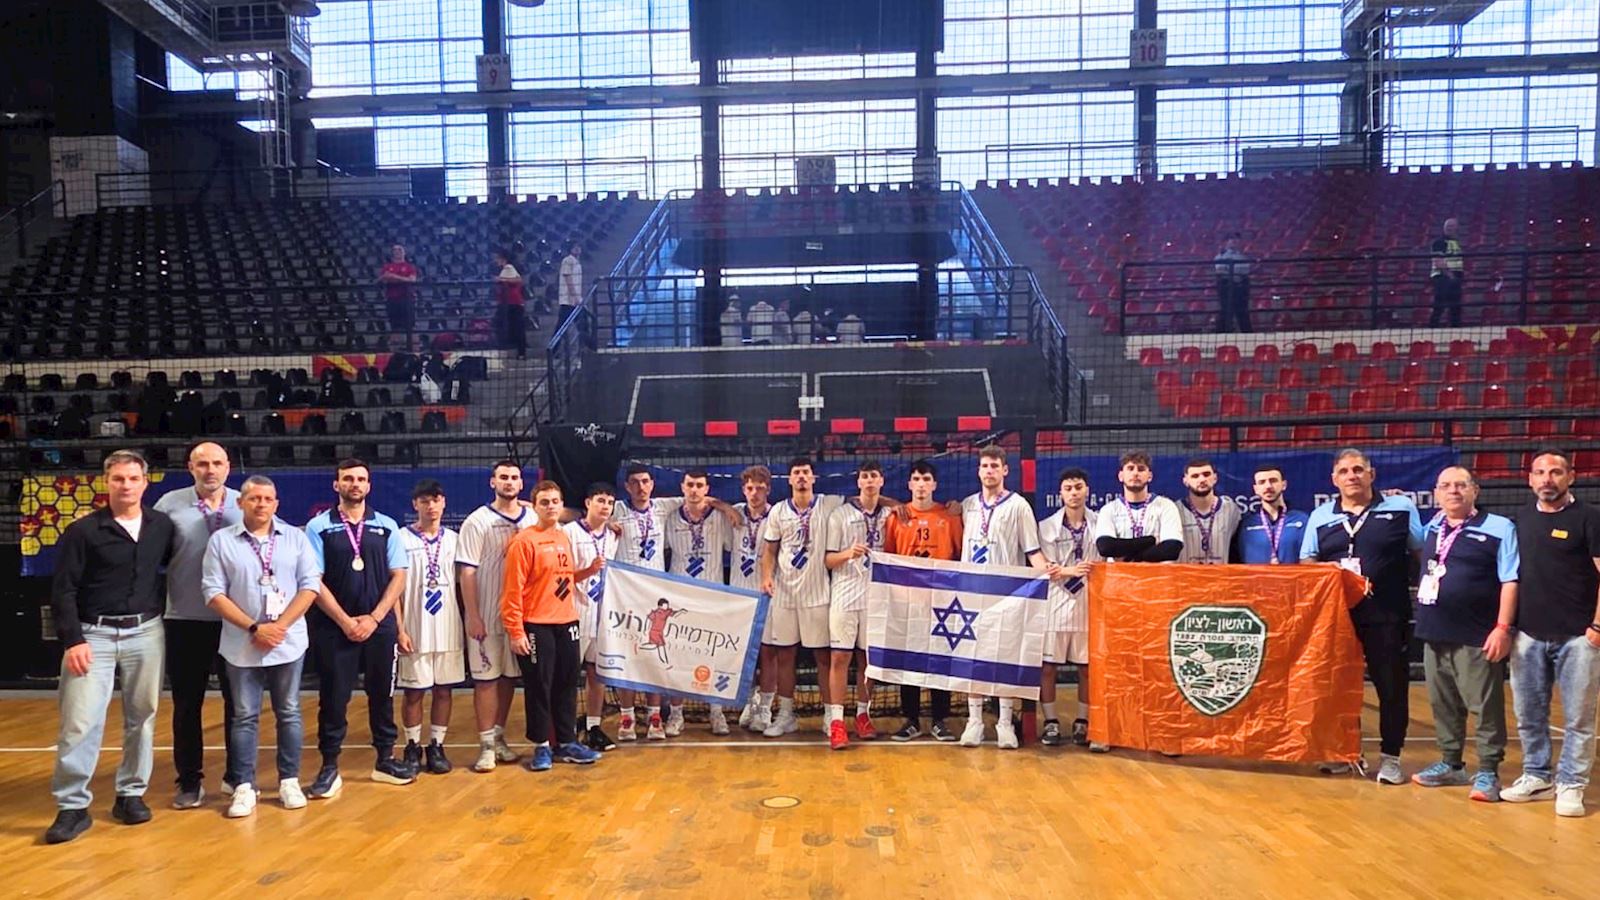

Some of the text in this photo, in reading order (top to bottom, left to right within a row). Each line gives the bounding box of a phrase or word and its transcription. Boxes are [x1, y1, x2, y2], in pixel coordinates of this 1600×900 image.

[1140, 43, 1158, 62] 10
[490, 69, 498, 85] 9
[917, 528, 930, 542] 13
[557, 554, 568, 567] 12
[1184, 615, 1252, 632] ראשון-לציון
[567, 625, 580, 641] 12
[665, 622, 740, 657] אקדמיית
